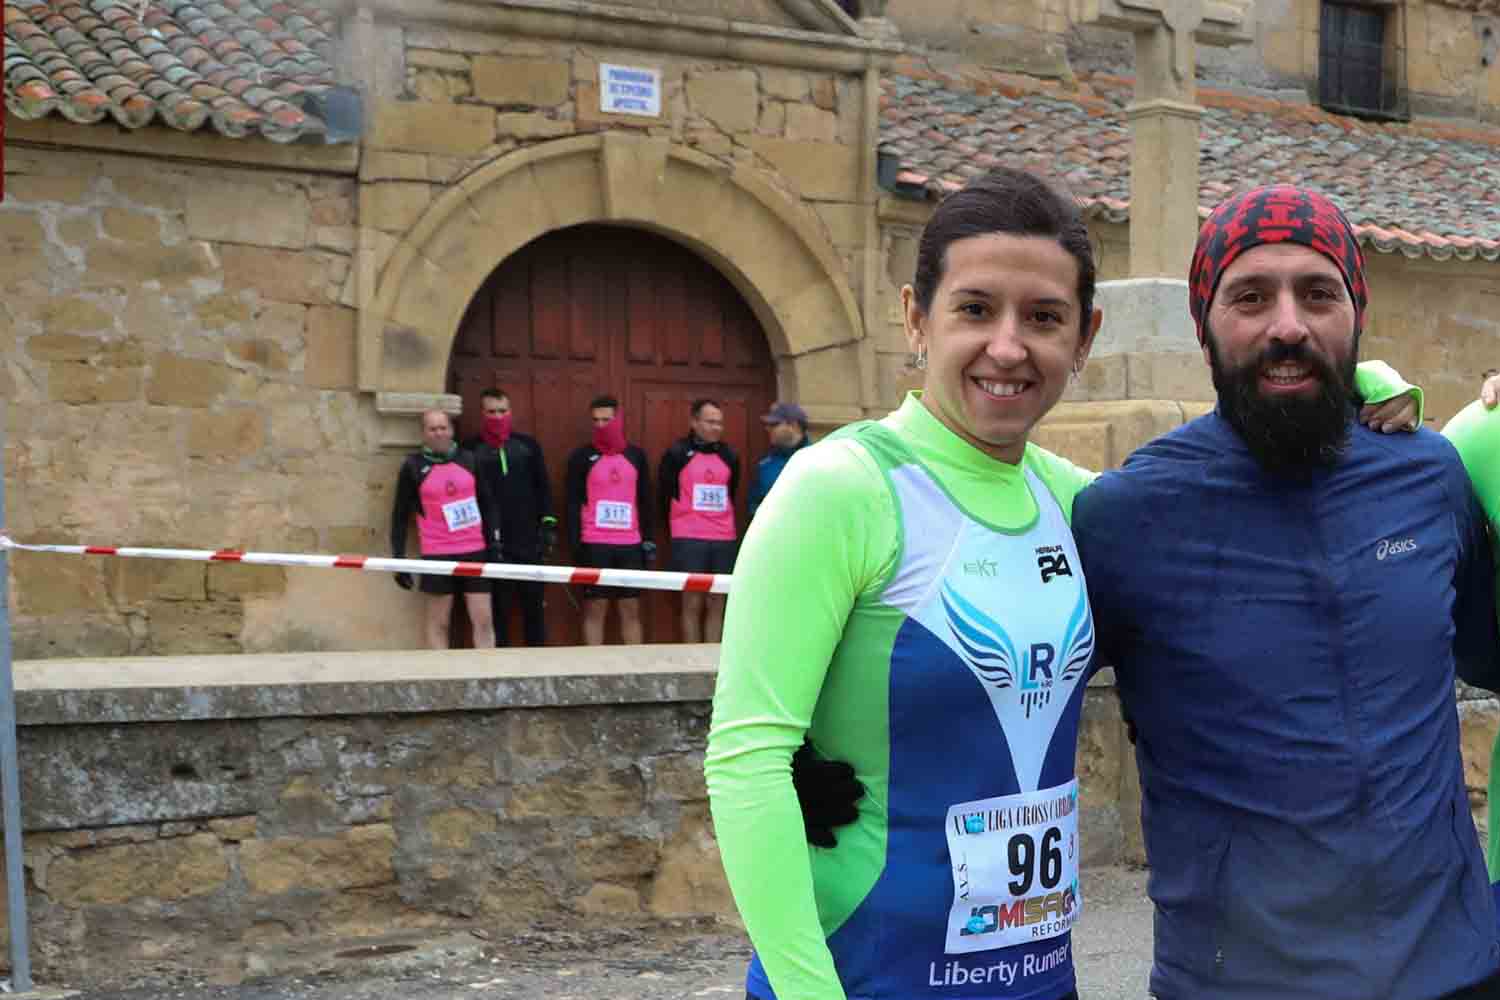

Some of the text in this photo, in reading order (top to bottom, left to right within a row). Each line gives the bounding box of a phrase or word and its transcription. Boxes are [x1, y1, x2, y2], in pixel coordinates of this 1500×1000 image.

[1038, 553, 1072, 583] 24
[988, 806, 1013, 832] LIGA
[1017, 797, 1049, 828] CROSS
[1007, 827, 1062, 896] 96
[929, 943, 1070, 987] Liberty Runner
